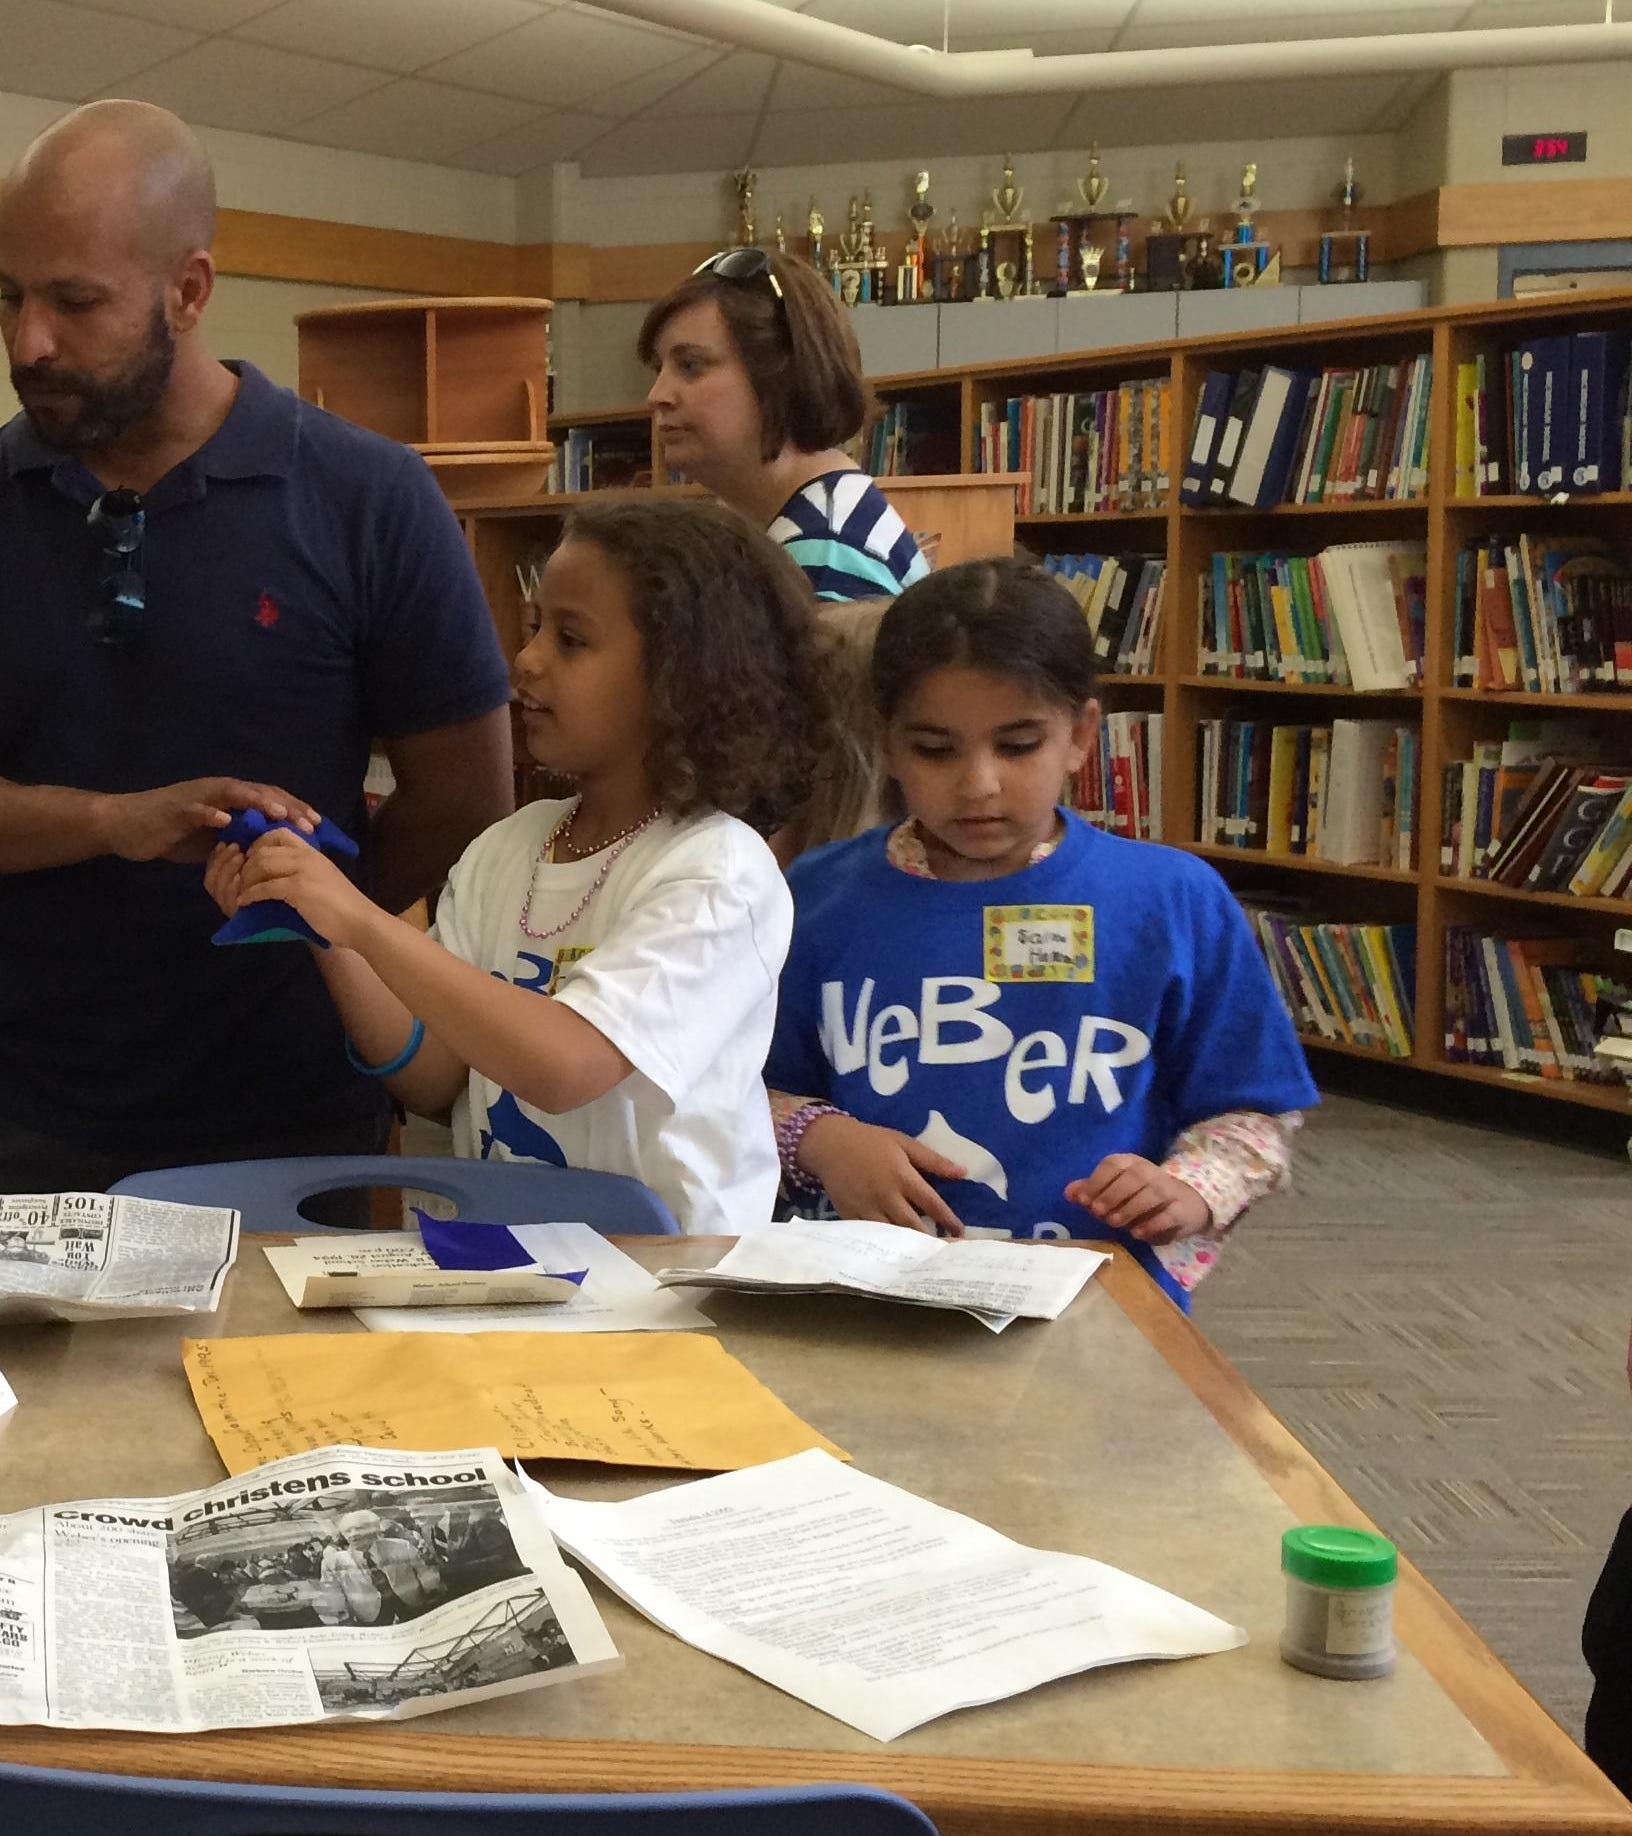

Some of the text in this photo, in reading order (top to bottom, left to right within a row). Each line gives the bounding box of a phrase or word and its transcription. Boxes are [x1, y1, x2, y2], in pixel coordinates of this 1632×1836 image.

[64, 1240, 95, 1253] Wait
[53, 1468, 487, 1532] Crowd christens school
